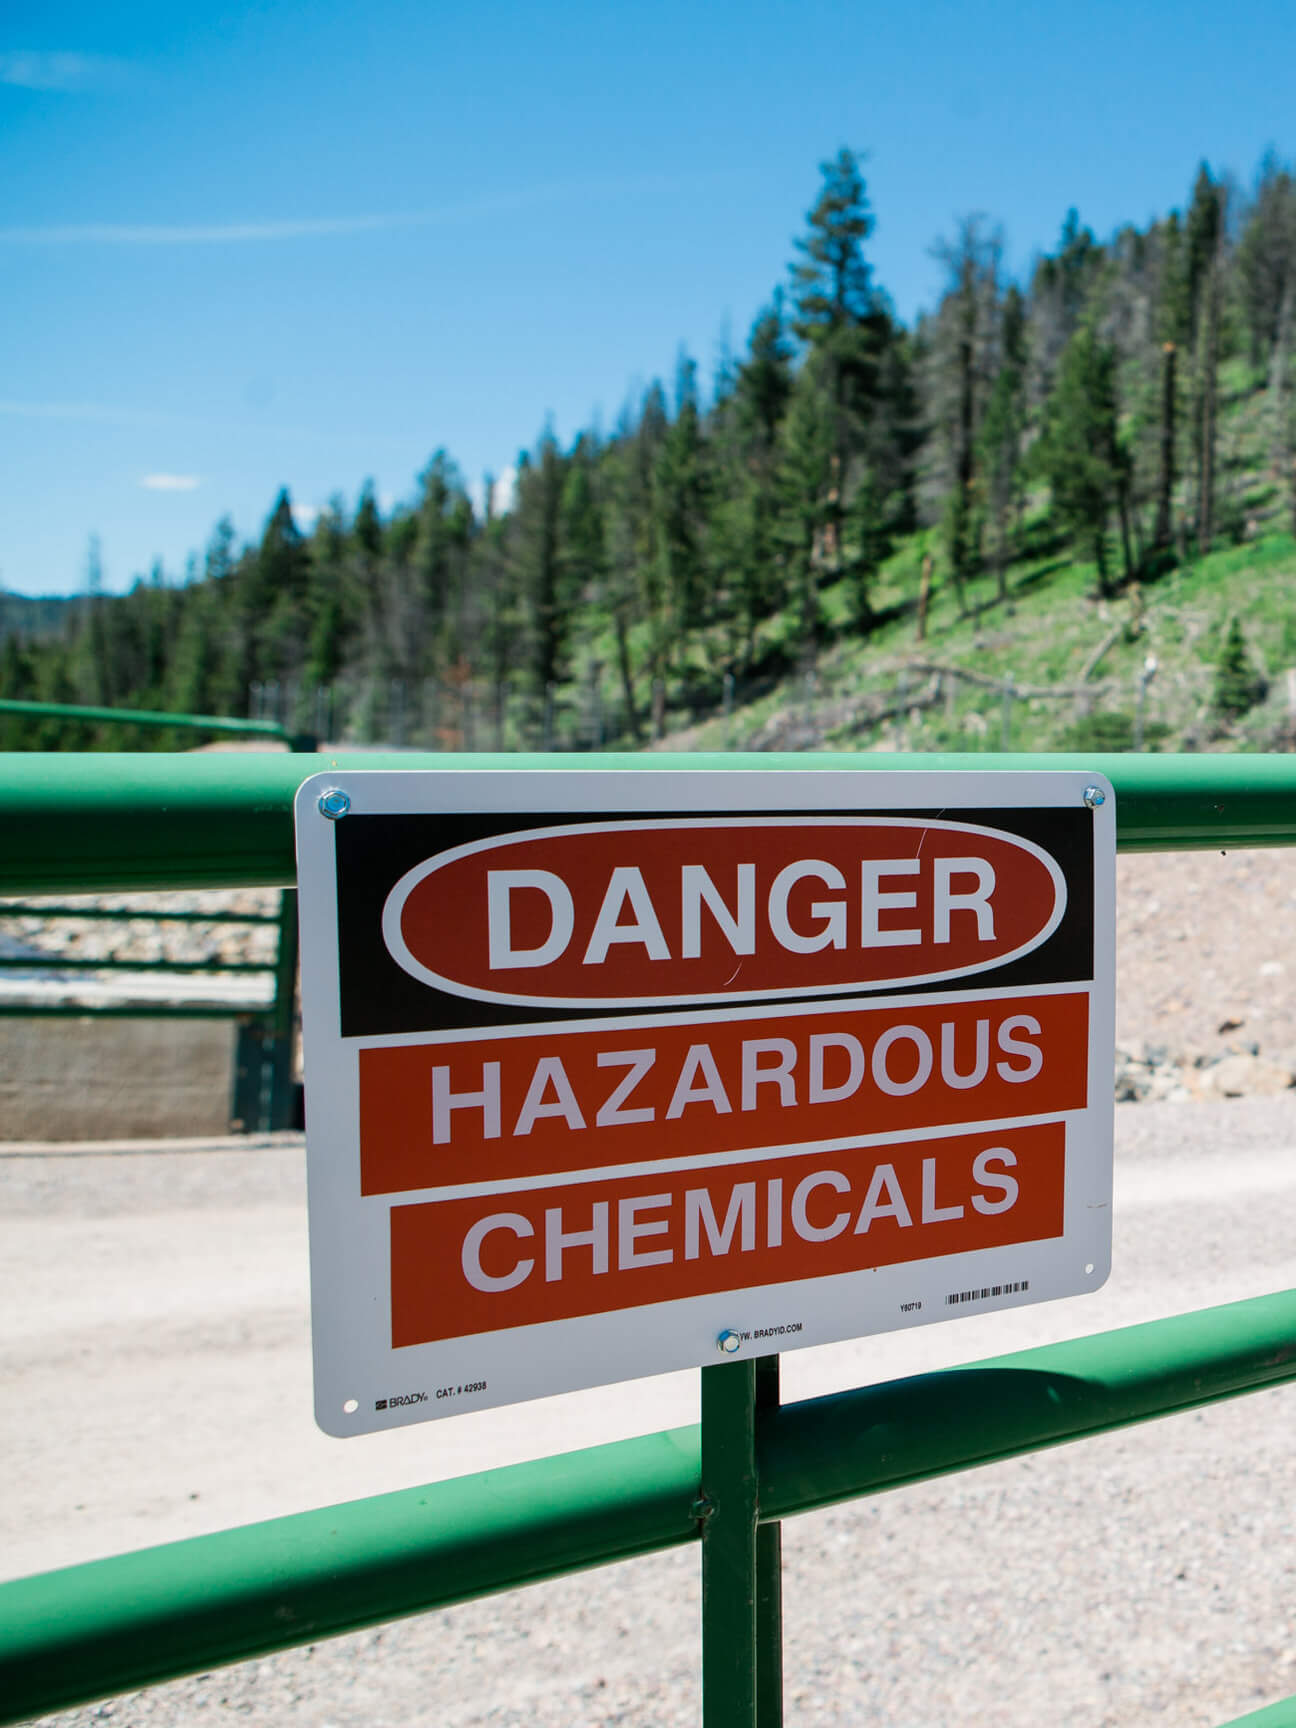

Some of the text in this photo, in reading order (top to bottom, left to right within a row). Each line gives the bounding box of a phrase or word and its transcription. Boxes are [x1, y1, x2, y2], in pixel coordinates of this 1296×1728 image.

[487, 856, 997, 970] DANGER
[431, 1014, 1043, 1145] HAZARDOUS
[461, 1147, 1019, 1293] CHEMICALS
[435, 1387, 456, 1400] CAT.
[463, 1380, 487, 1393] 42938
